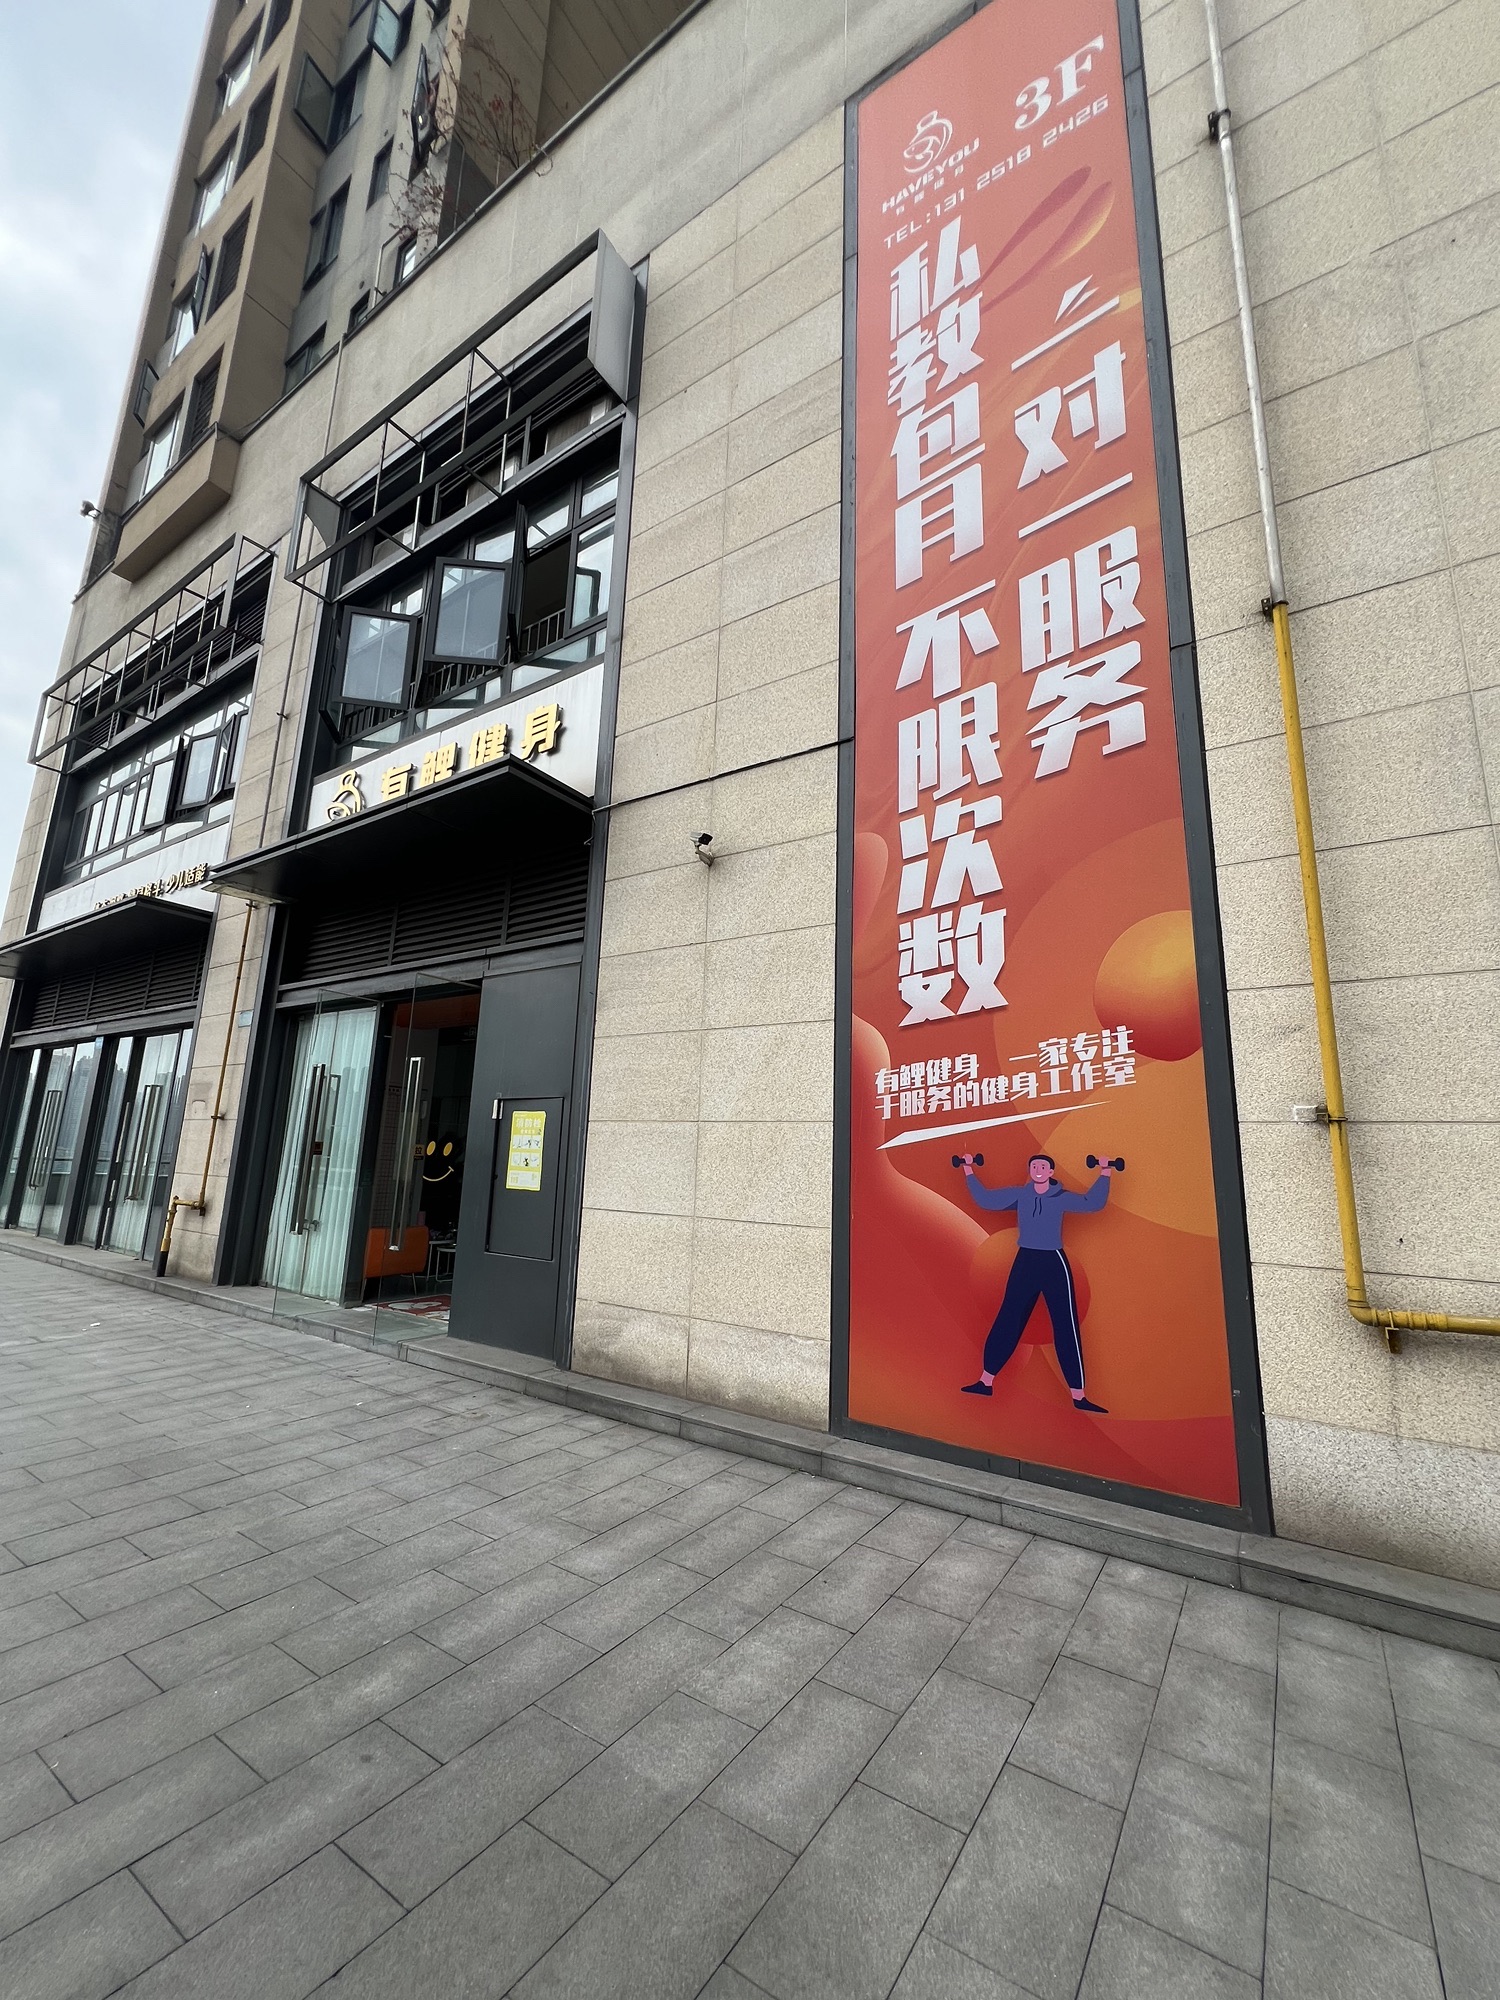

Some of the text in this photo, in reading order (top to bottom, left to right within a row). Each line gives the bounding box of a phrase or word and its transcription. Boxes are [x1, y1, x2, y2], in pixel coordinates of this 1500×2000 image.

[1013, 34, 1104, 130] 3F
[976, 144, 1031, 191] 2518
[1042, 94, 1109, 148] 2426
[1011, 294, 1149, 780] 一对一服务
[887, 215, 1009, 1028] 私教包月不限次数
[381, 702, 563, 801] 有鲤健身
[874, 1025, 1136, 1094] 有鲤健身 一家专注
[874, 1056, 1137, 1120] 于服务的健身工作室
